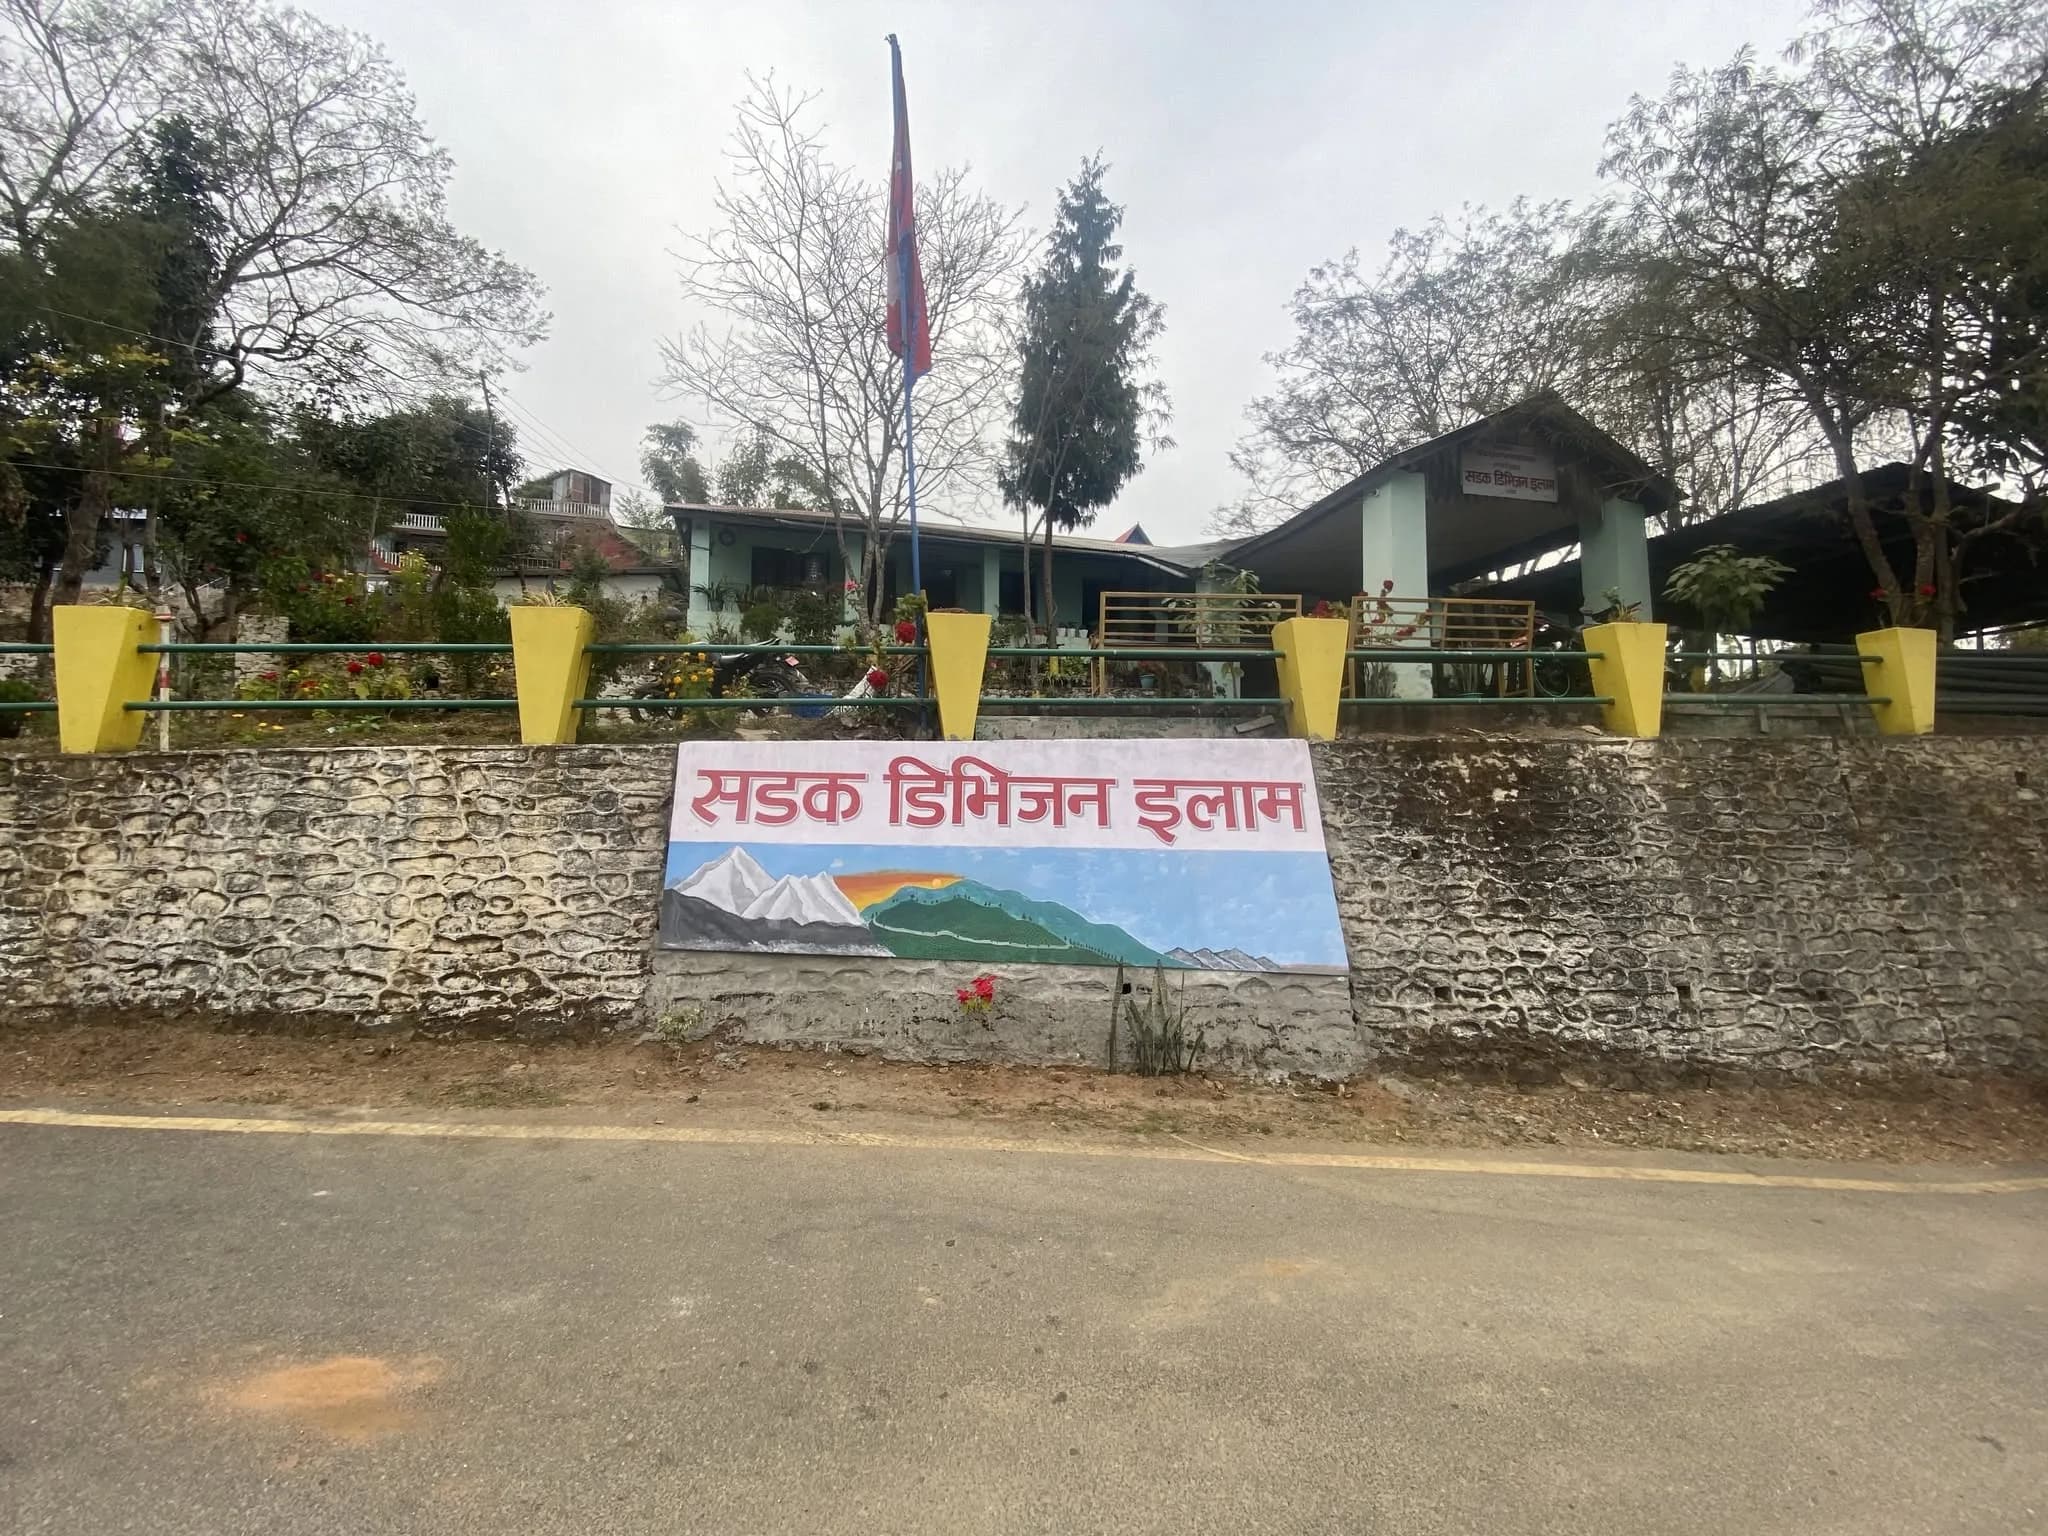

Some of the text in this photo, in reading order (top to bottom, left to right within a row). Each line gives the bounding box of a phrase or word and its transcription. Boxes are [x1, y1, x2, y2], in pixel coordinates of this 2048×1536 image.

[1464, 470, 1493, 484] सडक
[690, 756, 1306, 845] सडक डिभिजन इलाम
